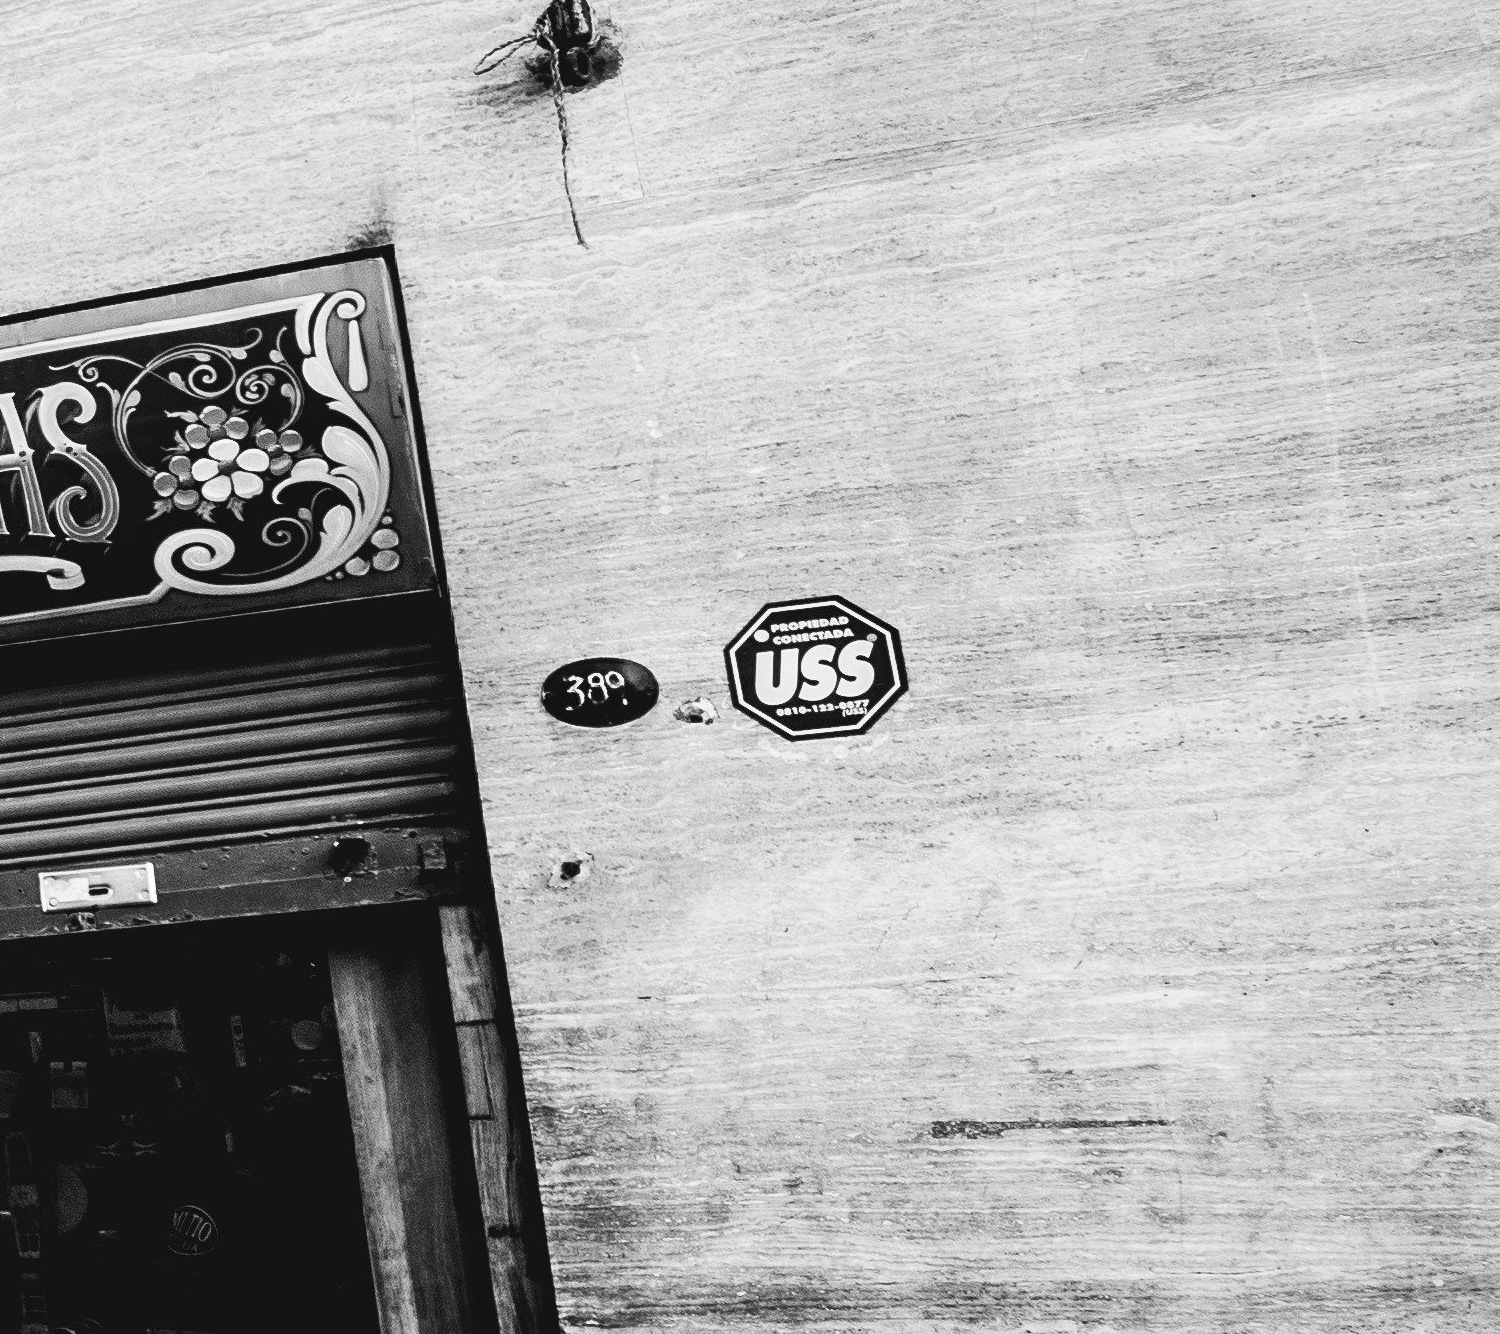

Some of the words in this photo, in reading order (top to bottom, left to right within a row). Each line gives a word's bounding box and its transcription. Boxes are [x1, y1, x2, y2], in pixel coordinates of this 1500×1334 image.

[770, 616, 849, 633] PROPIEDAD
[772, 628, 855, 645] CONECTADA
[755, 639, 875, 706] USS
[564, 671, 627, 711] 389
